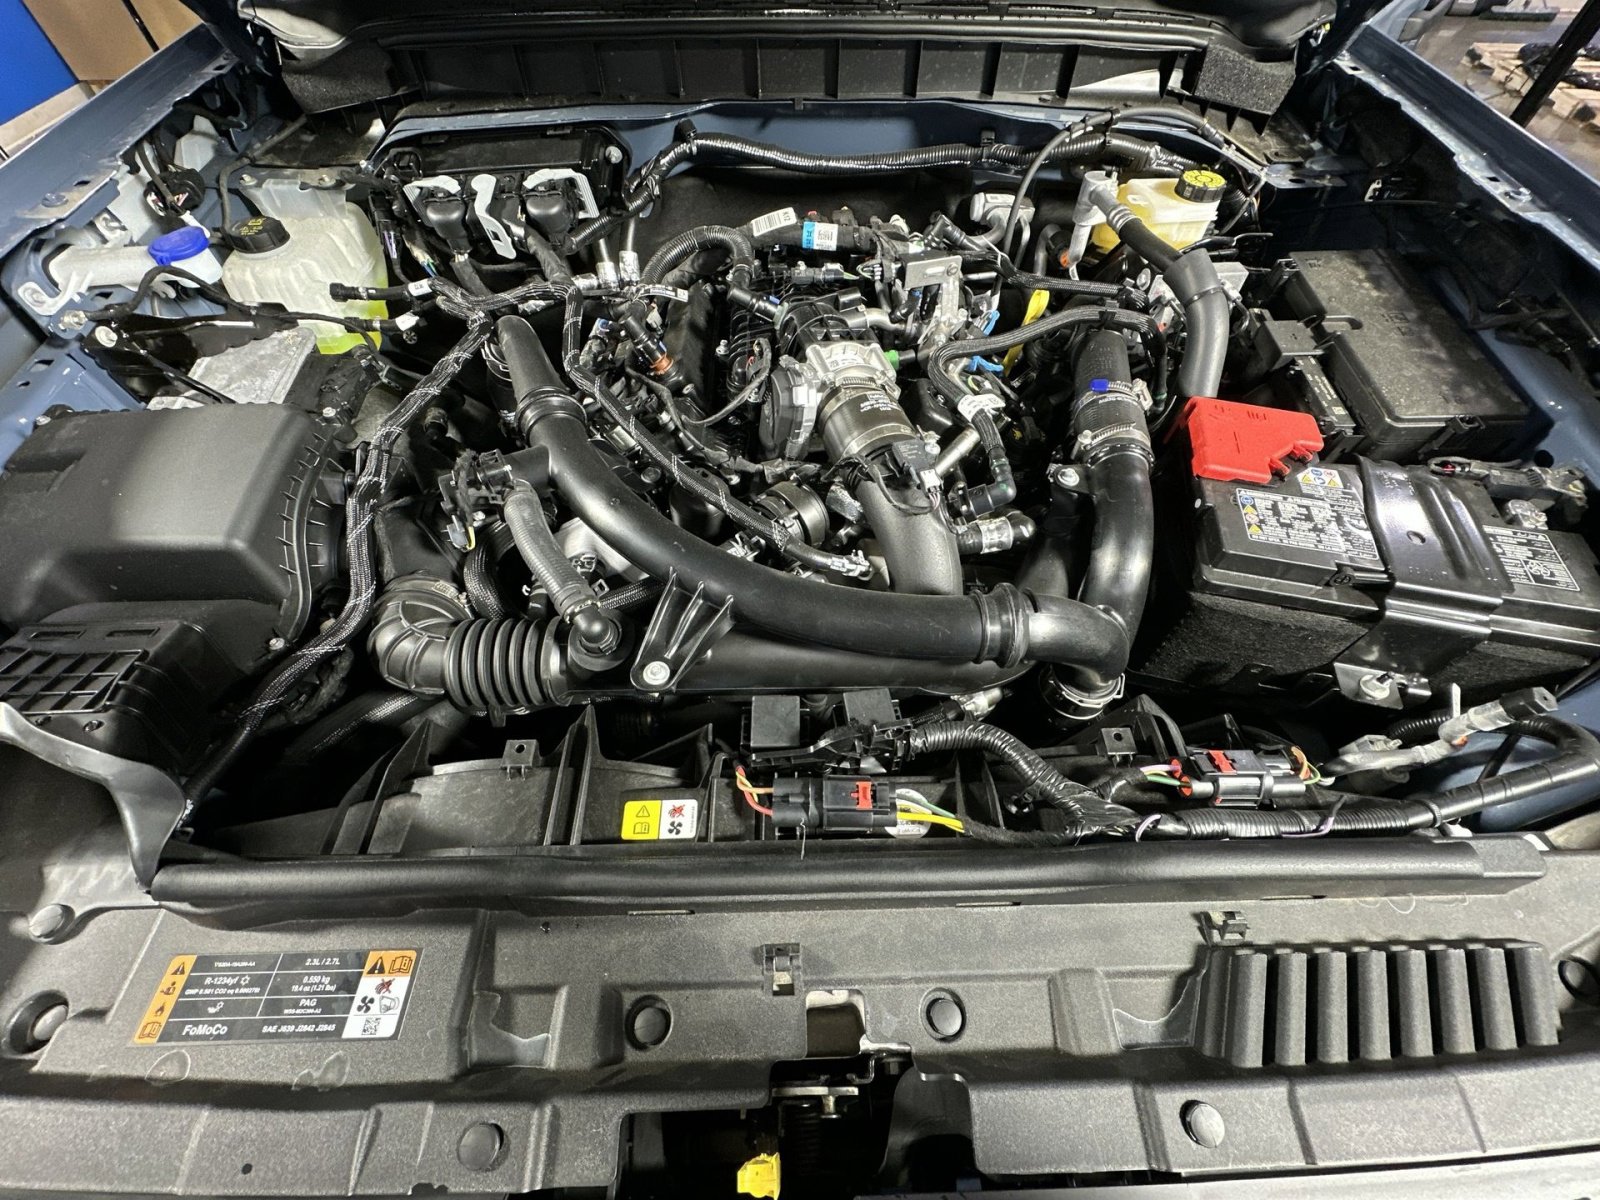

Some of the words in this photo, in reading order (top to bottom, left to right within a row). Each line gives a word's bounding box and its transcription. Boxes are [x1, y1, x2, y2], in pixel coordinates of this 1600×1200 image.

[305, 958, 320, 966] 2.3L
[325, 957, 341, 965] 2.7L
[204, 975, 239, 986] R-1234yf
[321, 975, 331, 985] kg
[299, 998, 318, 1007] PAG
[181, 1023, 229, 1036] FoMoCo
[261, 1025, 278, 1033] SAE
